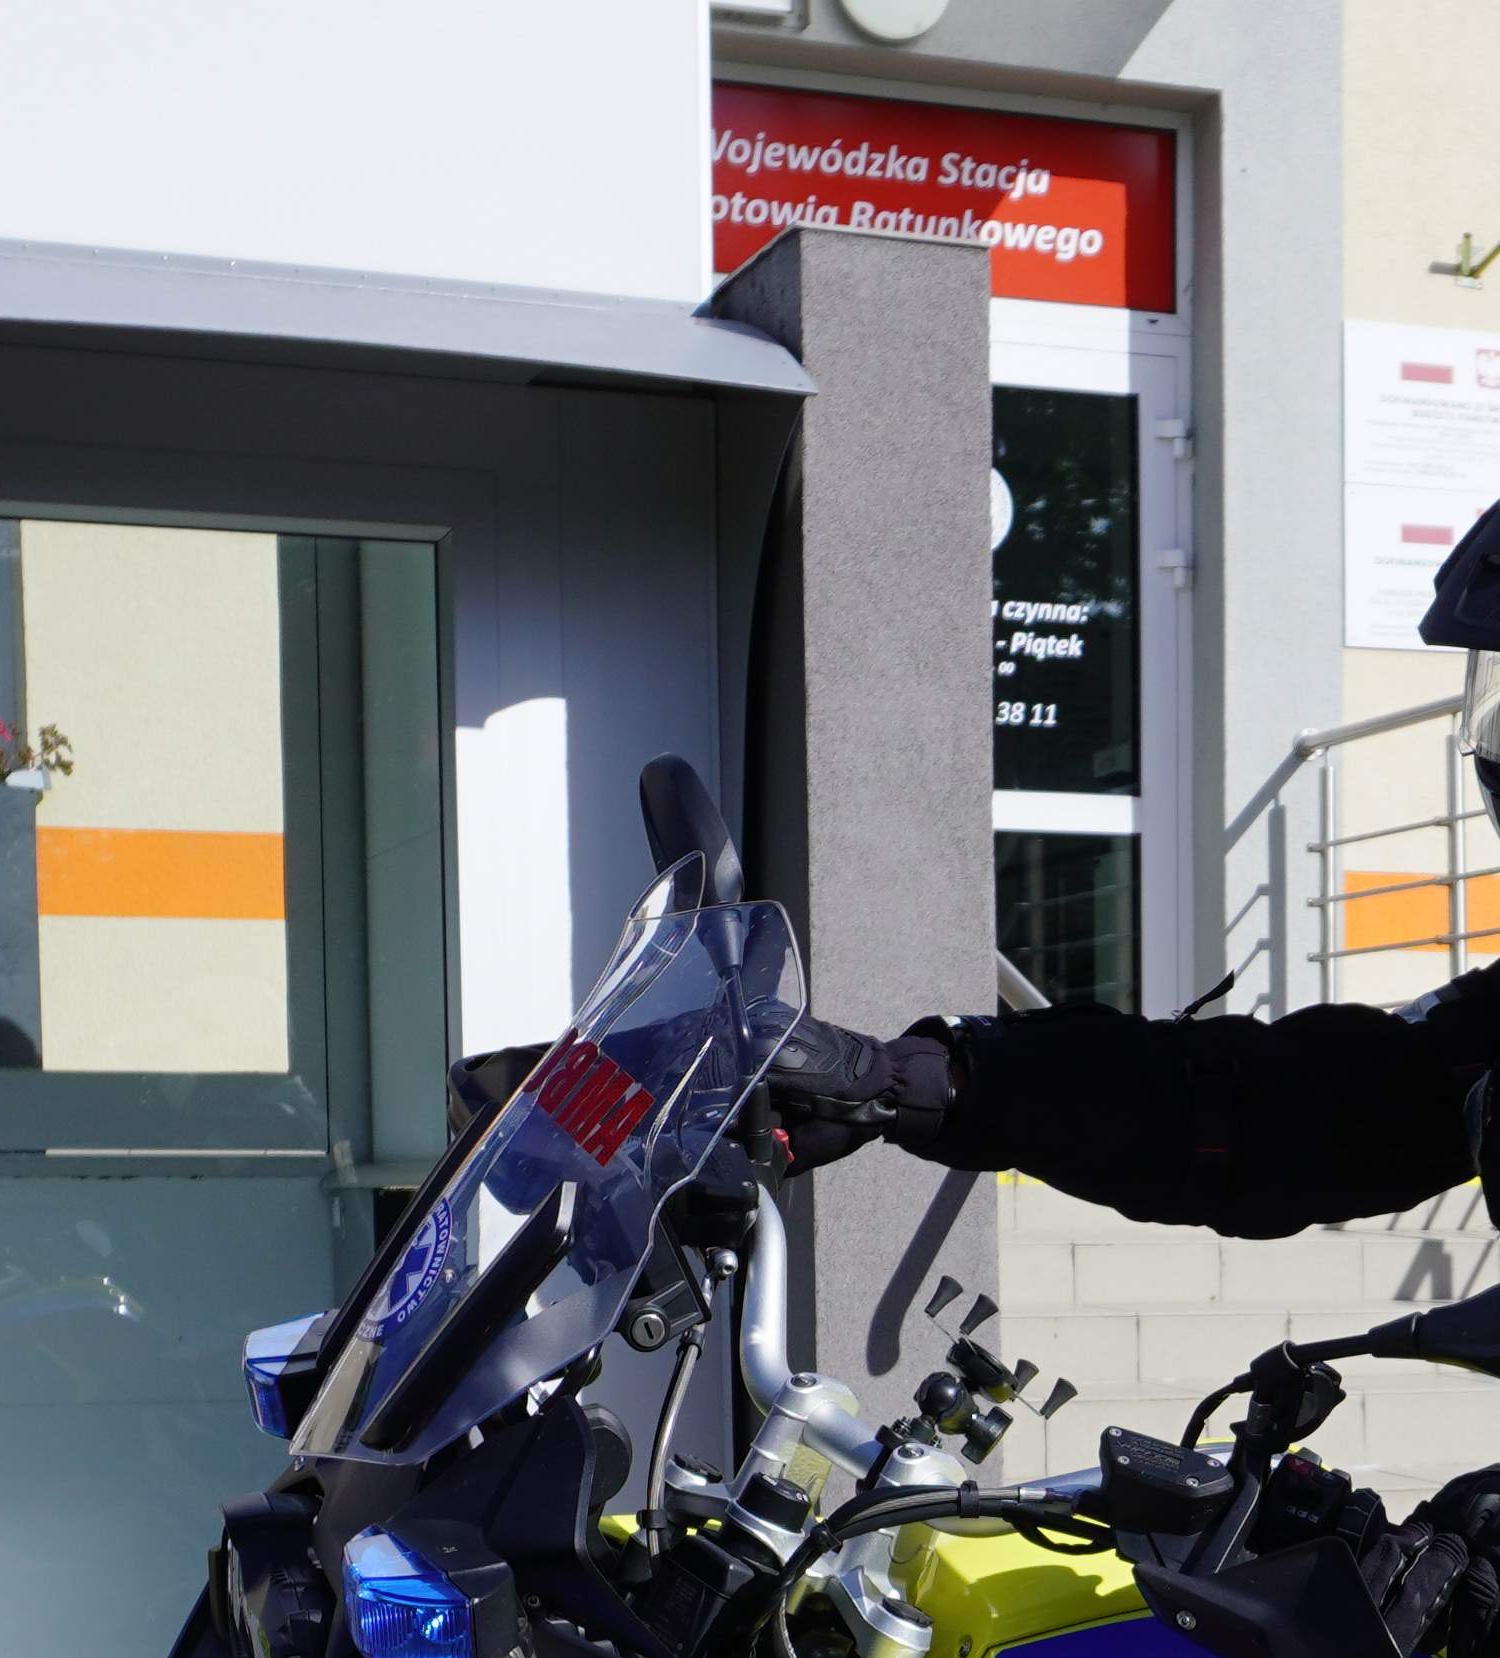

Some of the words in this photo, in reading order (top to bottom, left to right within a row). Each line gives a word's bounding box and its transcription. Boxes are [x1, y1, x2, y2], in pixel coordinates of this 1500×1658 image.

[937, 150, 1051, 200] Stacja
[711, 191, 839, 226] otowia
[850, 200, 1104, 261] Ratunkowego
[1002, 600, 1088, 625] czynna:
[1009, 631, 1085, 662] Piątek
[995, 701, 1027, 726] 38
[1029, 703, 1058, 727] 11
[397, 1203, 449, 1323] RATOWNICTWO
[358, 1324, 385, 1338] CZNE
